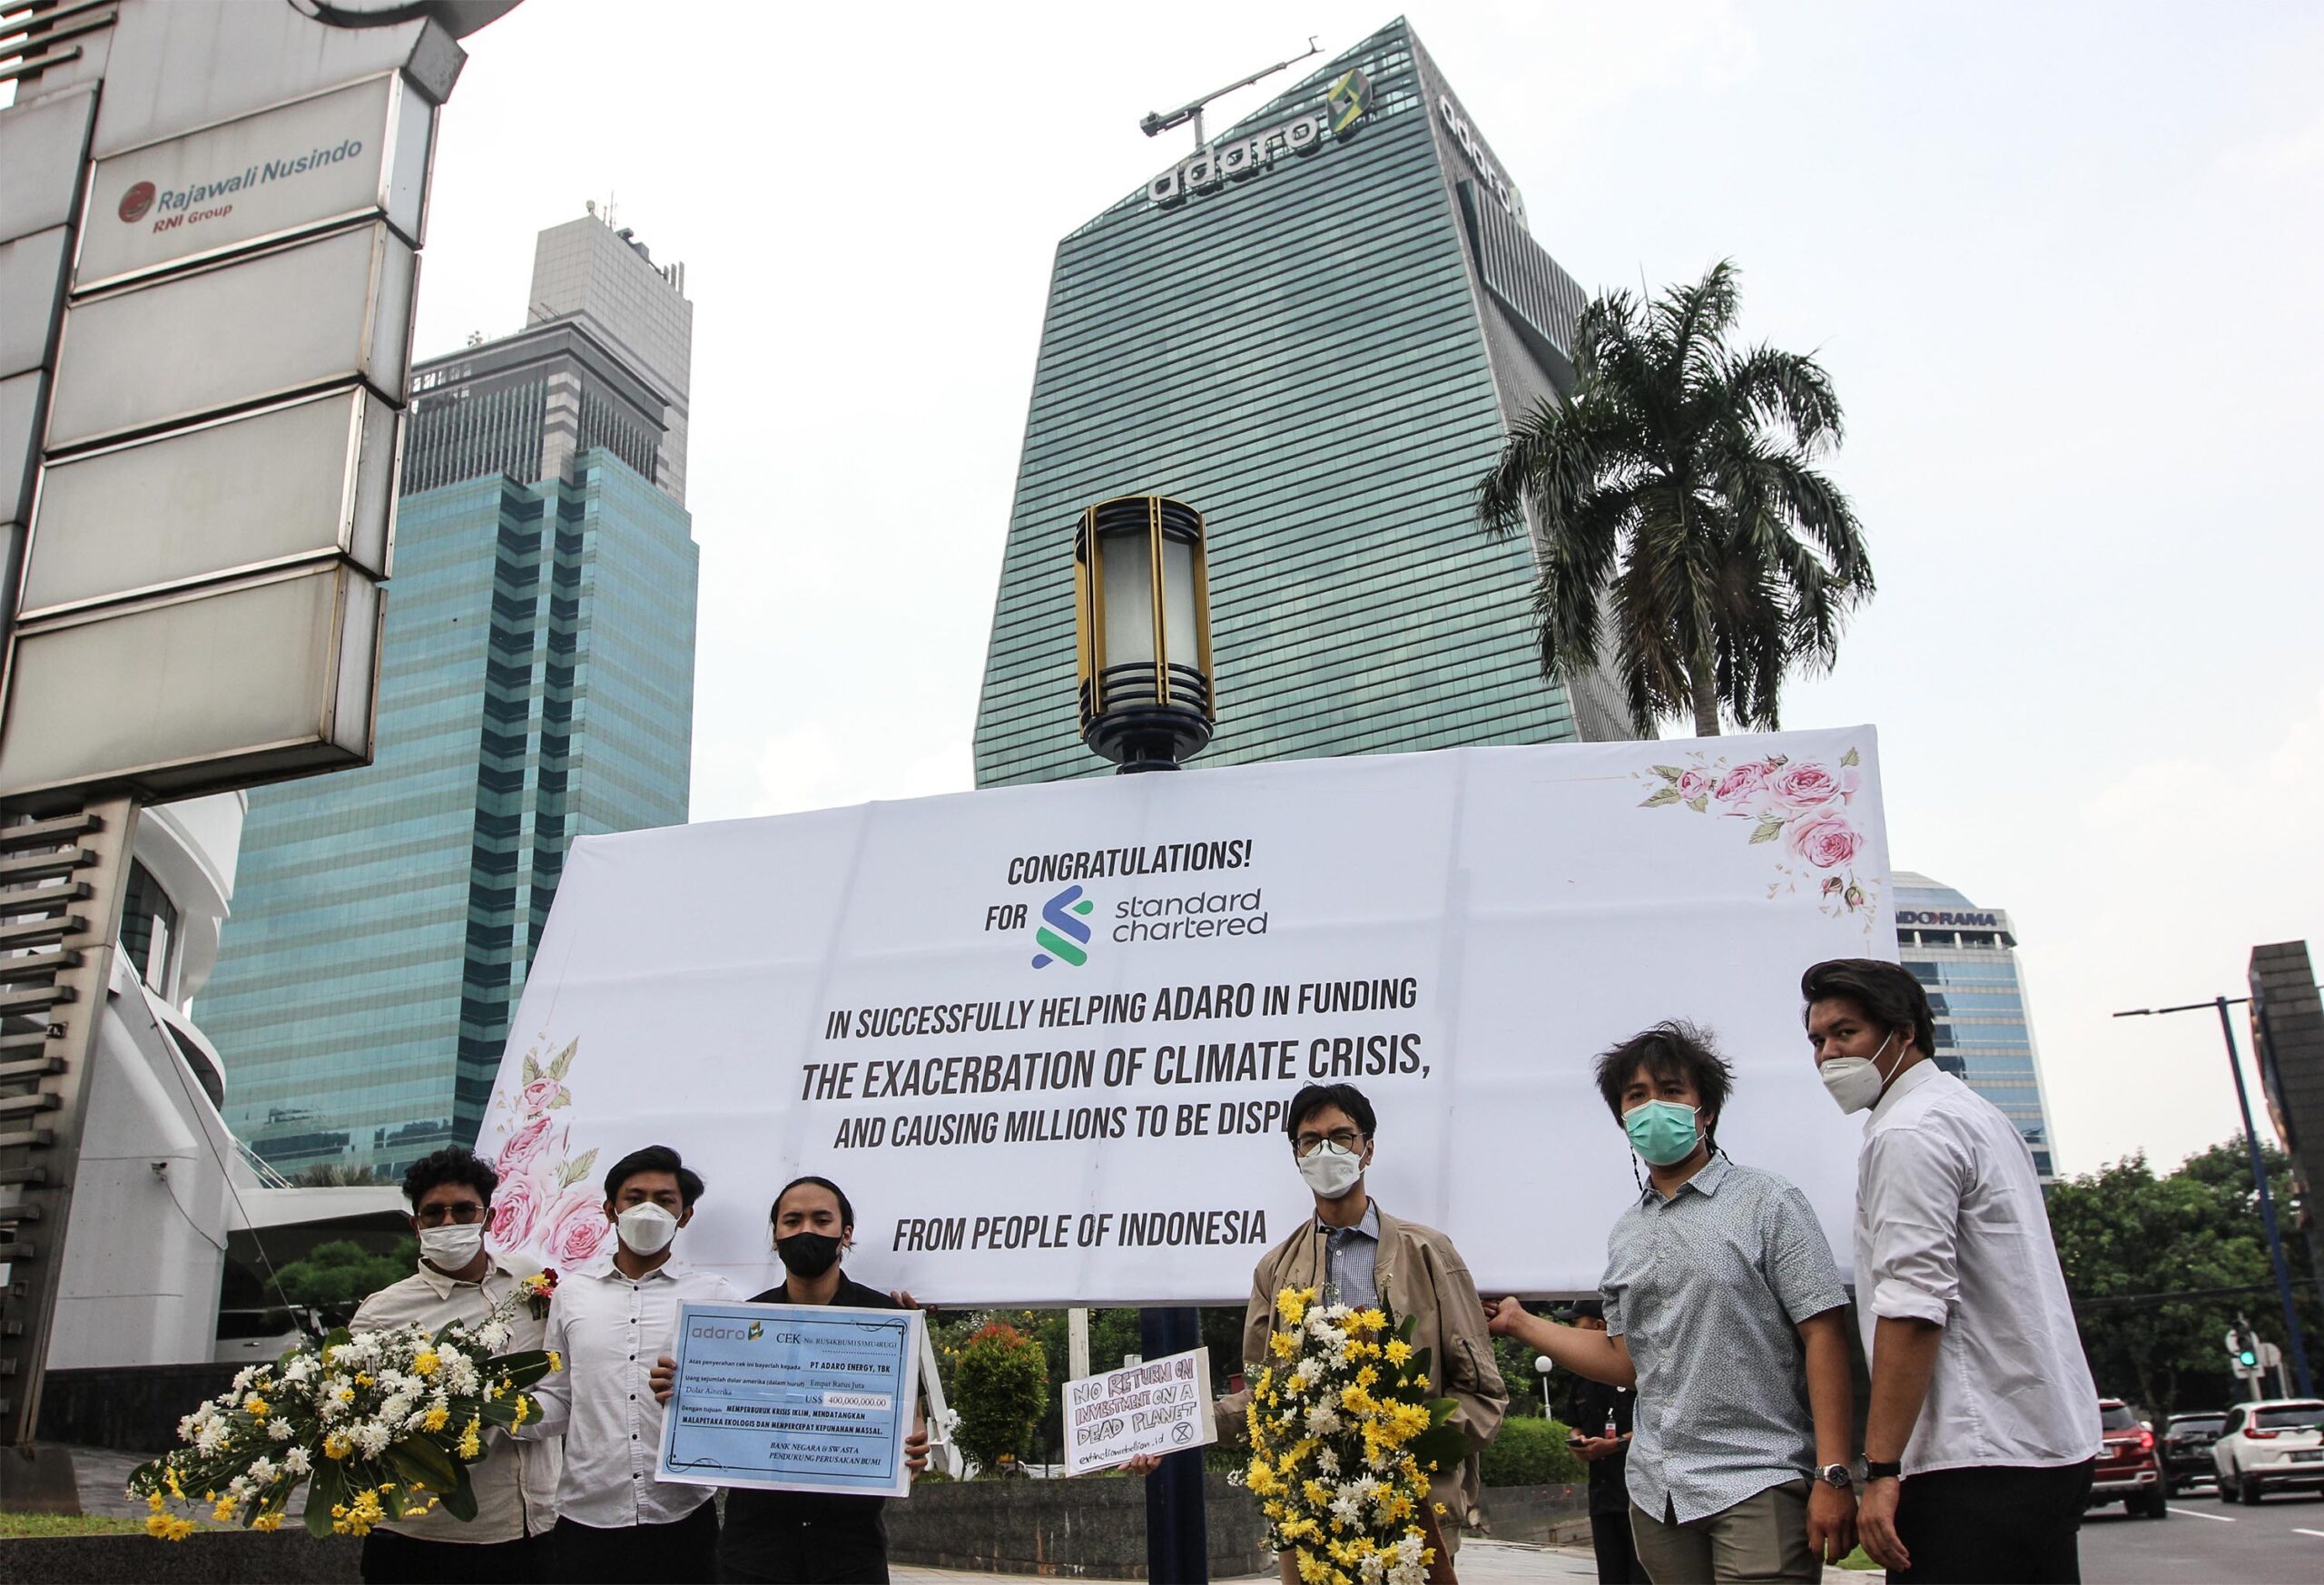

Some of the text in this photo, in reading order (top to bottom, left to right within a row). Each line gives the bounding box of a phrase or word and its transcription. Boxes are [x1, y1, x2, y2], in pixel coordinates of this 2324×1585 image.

[1147, 116, 1318, 202] adaro
[1439, 94, 1511, 213] adaro
[156, 139, 362, 213] Rajawali Nusindo
[153, 204, 232, 233] RNI Group
[1008, 839, 1252, 885] CONGRATULATIONS!
[985, 903, 1028, 930] FOR
[1115, 888, 1262, 920] standard
[1896, 911, 1997, 926] NDORAMA
[1112, 911, 1269, 943] chartered
[825, 977, 1417, 1039] IN SUCCESSFULLY HELPING ADARO IN FUNDING
[802, 1033, 1431, 1100] THE EXACERBATION OF CLIMATE CRISIS,
[833, 1100, 1290, 1149] AND CAUSING MILLIONS TO BE DISPL
[892, 1210, 1267, 1252] FROM PEOPLE OF INDONESIA
[692, 1326, 745, 1341] adaro
[776, 1333, 802, 1344] CEK
[702, 1359, 734, 1367] penyerahan
[754, 1362, 779, 1370] bayarlah
[810, 1361, 819, 1369] PT
[820, 1362, 844, 1371] ADARO
[847, 1363, 875, 1373] ENERGY,
[877, 1365, 891, 1373] TBK
[1073, 1358, 1194, 1405] NO RETURN ON
[701, 1376, 726, 1384] sejumlah
[810, 1379, 831, 1388] Empat
[832, 1380, 851, 1389] Ratus
[852, 1381, 865, 1391] Juta
[681, 1404, 703, 1413] Dengan
[726, 1404, 771, 1414] MEMPERBURUK
[772, 1407, 791, 1416] KRISIS
[792, 1409, 812, 1418] IKLIM,
[812, 1410, 865, 1420] MENDATANGKAN
[828, 1397, 887, 1407] 400,000,000.00
[1075, 1383, 1195, 1427] INVESTMENT ON A
[682, 1415, 724, 1425] MALAPETAKA
[724, 1419, 755, 1428] EKOLOGIS
[771, 1421, 814, 1432] MEMPERCEPAT
[815, 1424, 854, 1433] KEPUNAHAN
[854, 1426, 883, 1435] MASSAL.
[1077, 1401, 1197, 1446] DEAD PLANET
[769, 1452, 881, 1466] PENDUKUNG PERUSAKAN BUMI
[770, 1442, 791, 1451] BANK
[792, 1443, 822, 1452] NEGARA
